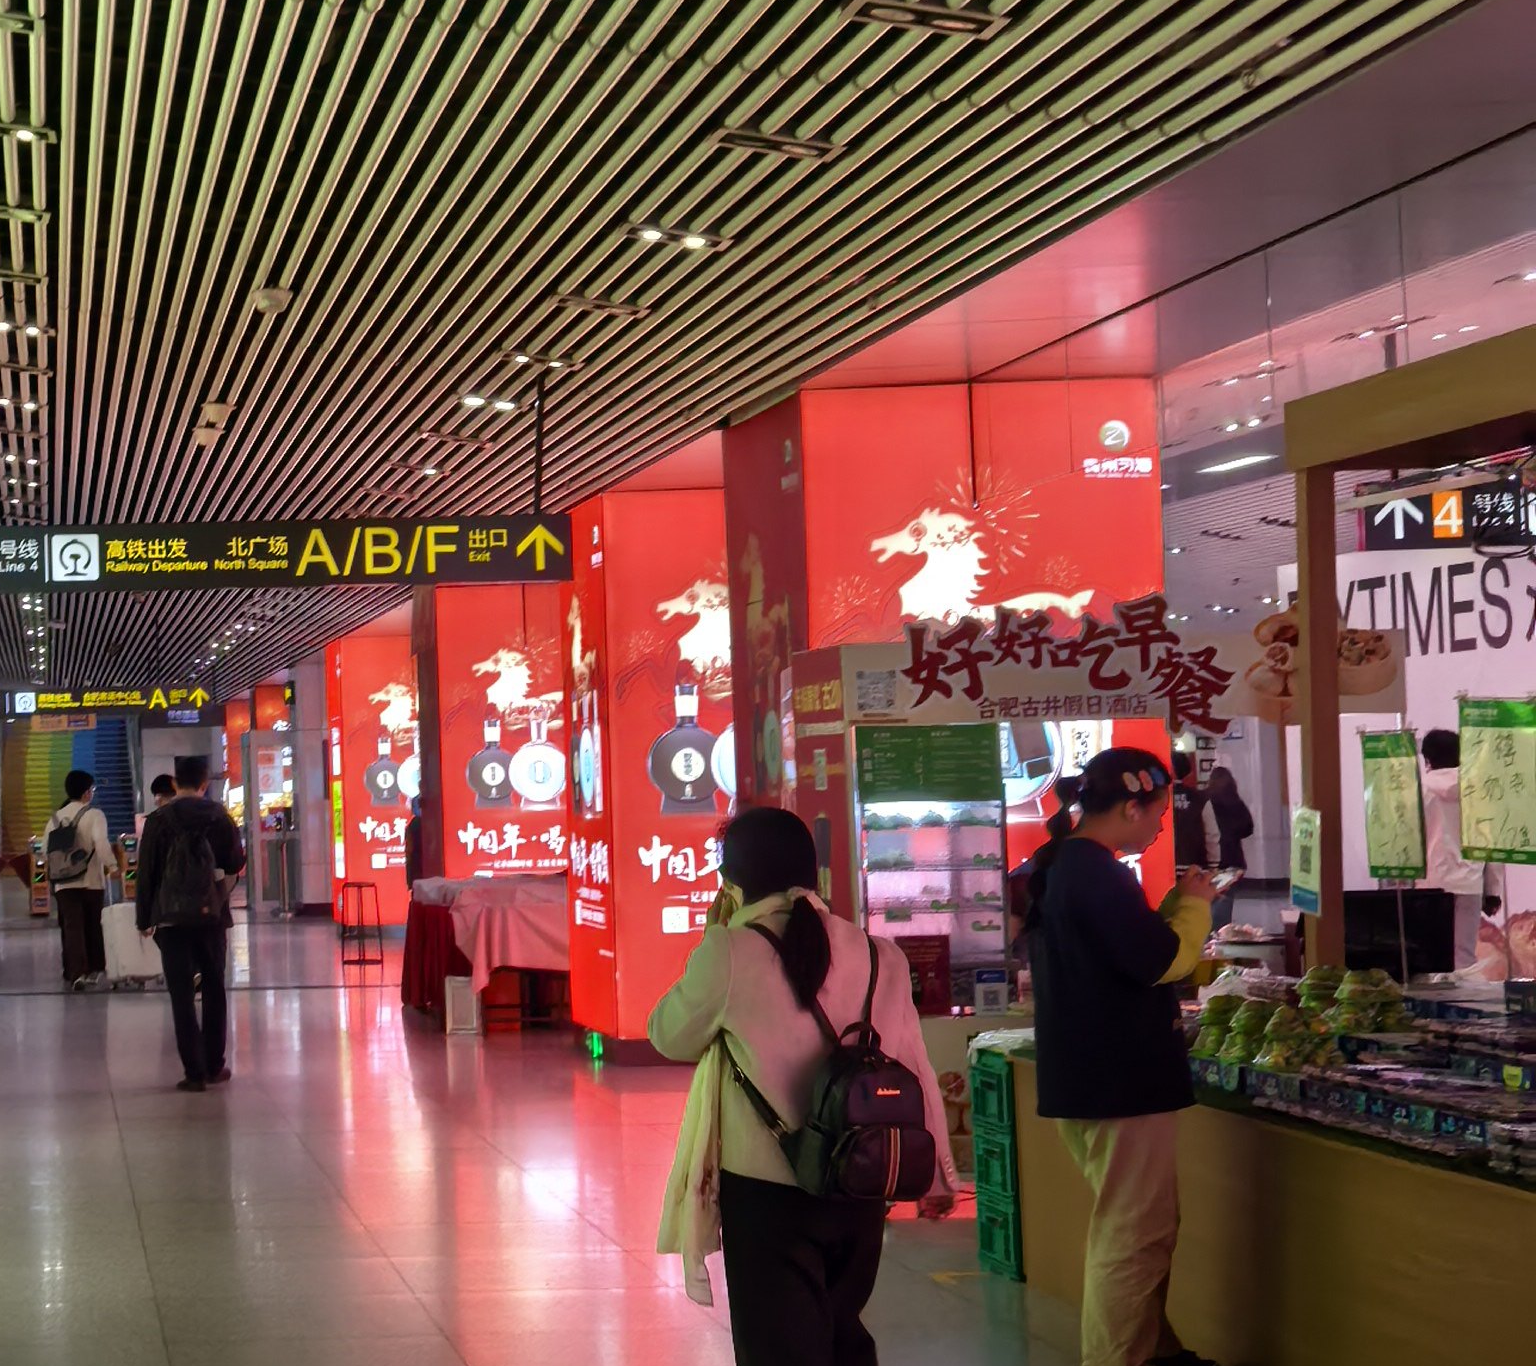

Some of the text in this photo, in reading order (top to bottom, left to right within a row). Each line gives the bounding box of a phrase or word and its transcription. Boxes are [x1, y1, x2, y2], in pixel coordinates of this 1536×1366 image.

[1433, 496, 1463, 535] 4
[29, 560, 39, 572] 4
[105, 560, 150, 574] Railway
[152, 559, 208, 573] Departure
[215, 558, 246, 571] North
[248, 558, 289, 572] Square
[468, 551, 491, 563] Exit
[105, 538, 188, 560] 高铁出发
[227, 535, 289, 558] 北广场
[295, 524, 460, 577] A/B/F
[468, 527, 508, 550] 出口
[901, 595, 1237, 734] 好好吃早餐
[148, 688, 168, 710] A
[977, 693, 1148, 720] 合肥古井假日酒店
